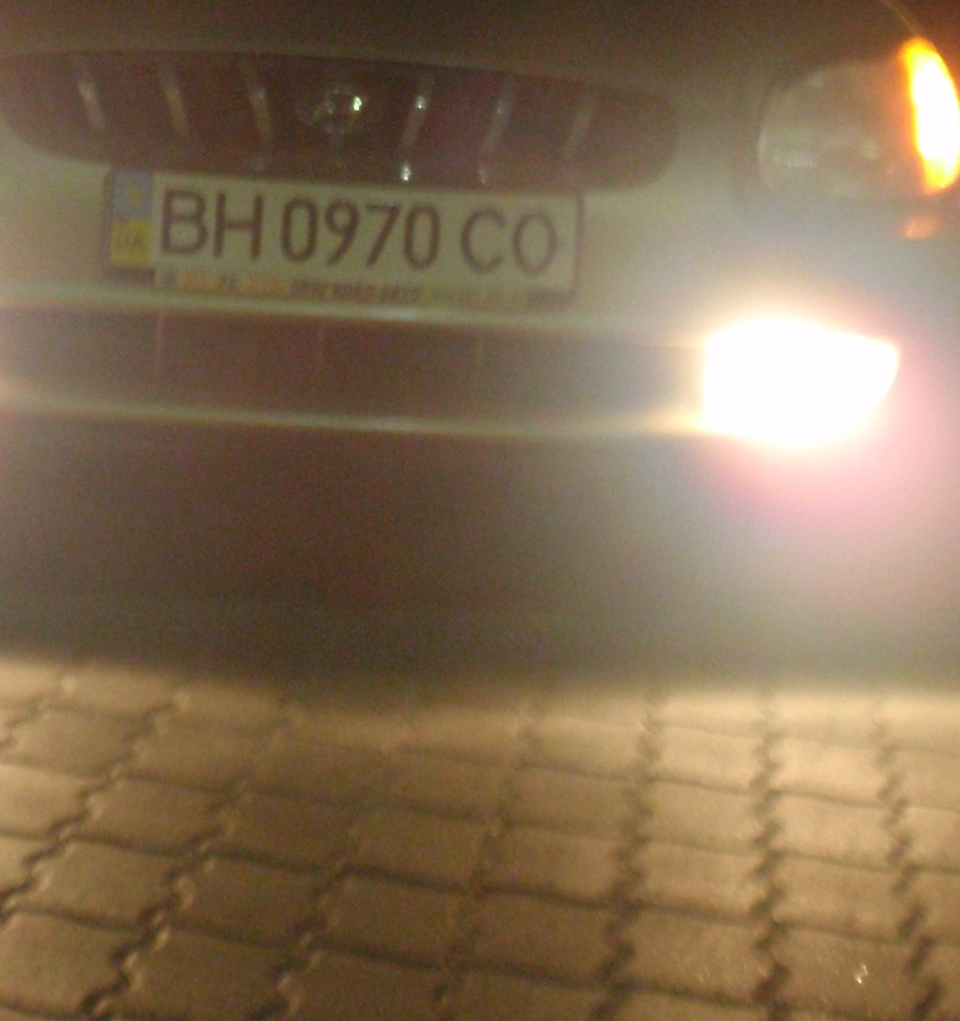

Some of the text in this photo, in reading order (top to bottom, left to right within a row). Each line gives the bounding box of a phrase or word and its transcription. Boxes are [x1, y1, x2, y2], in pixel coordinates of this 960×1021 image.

[159, 189, 557, 273] BH 0970 CO
